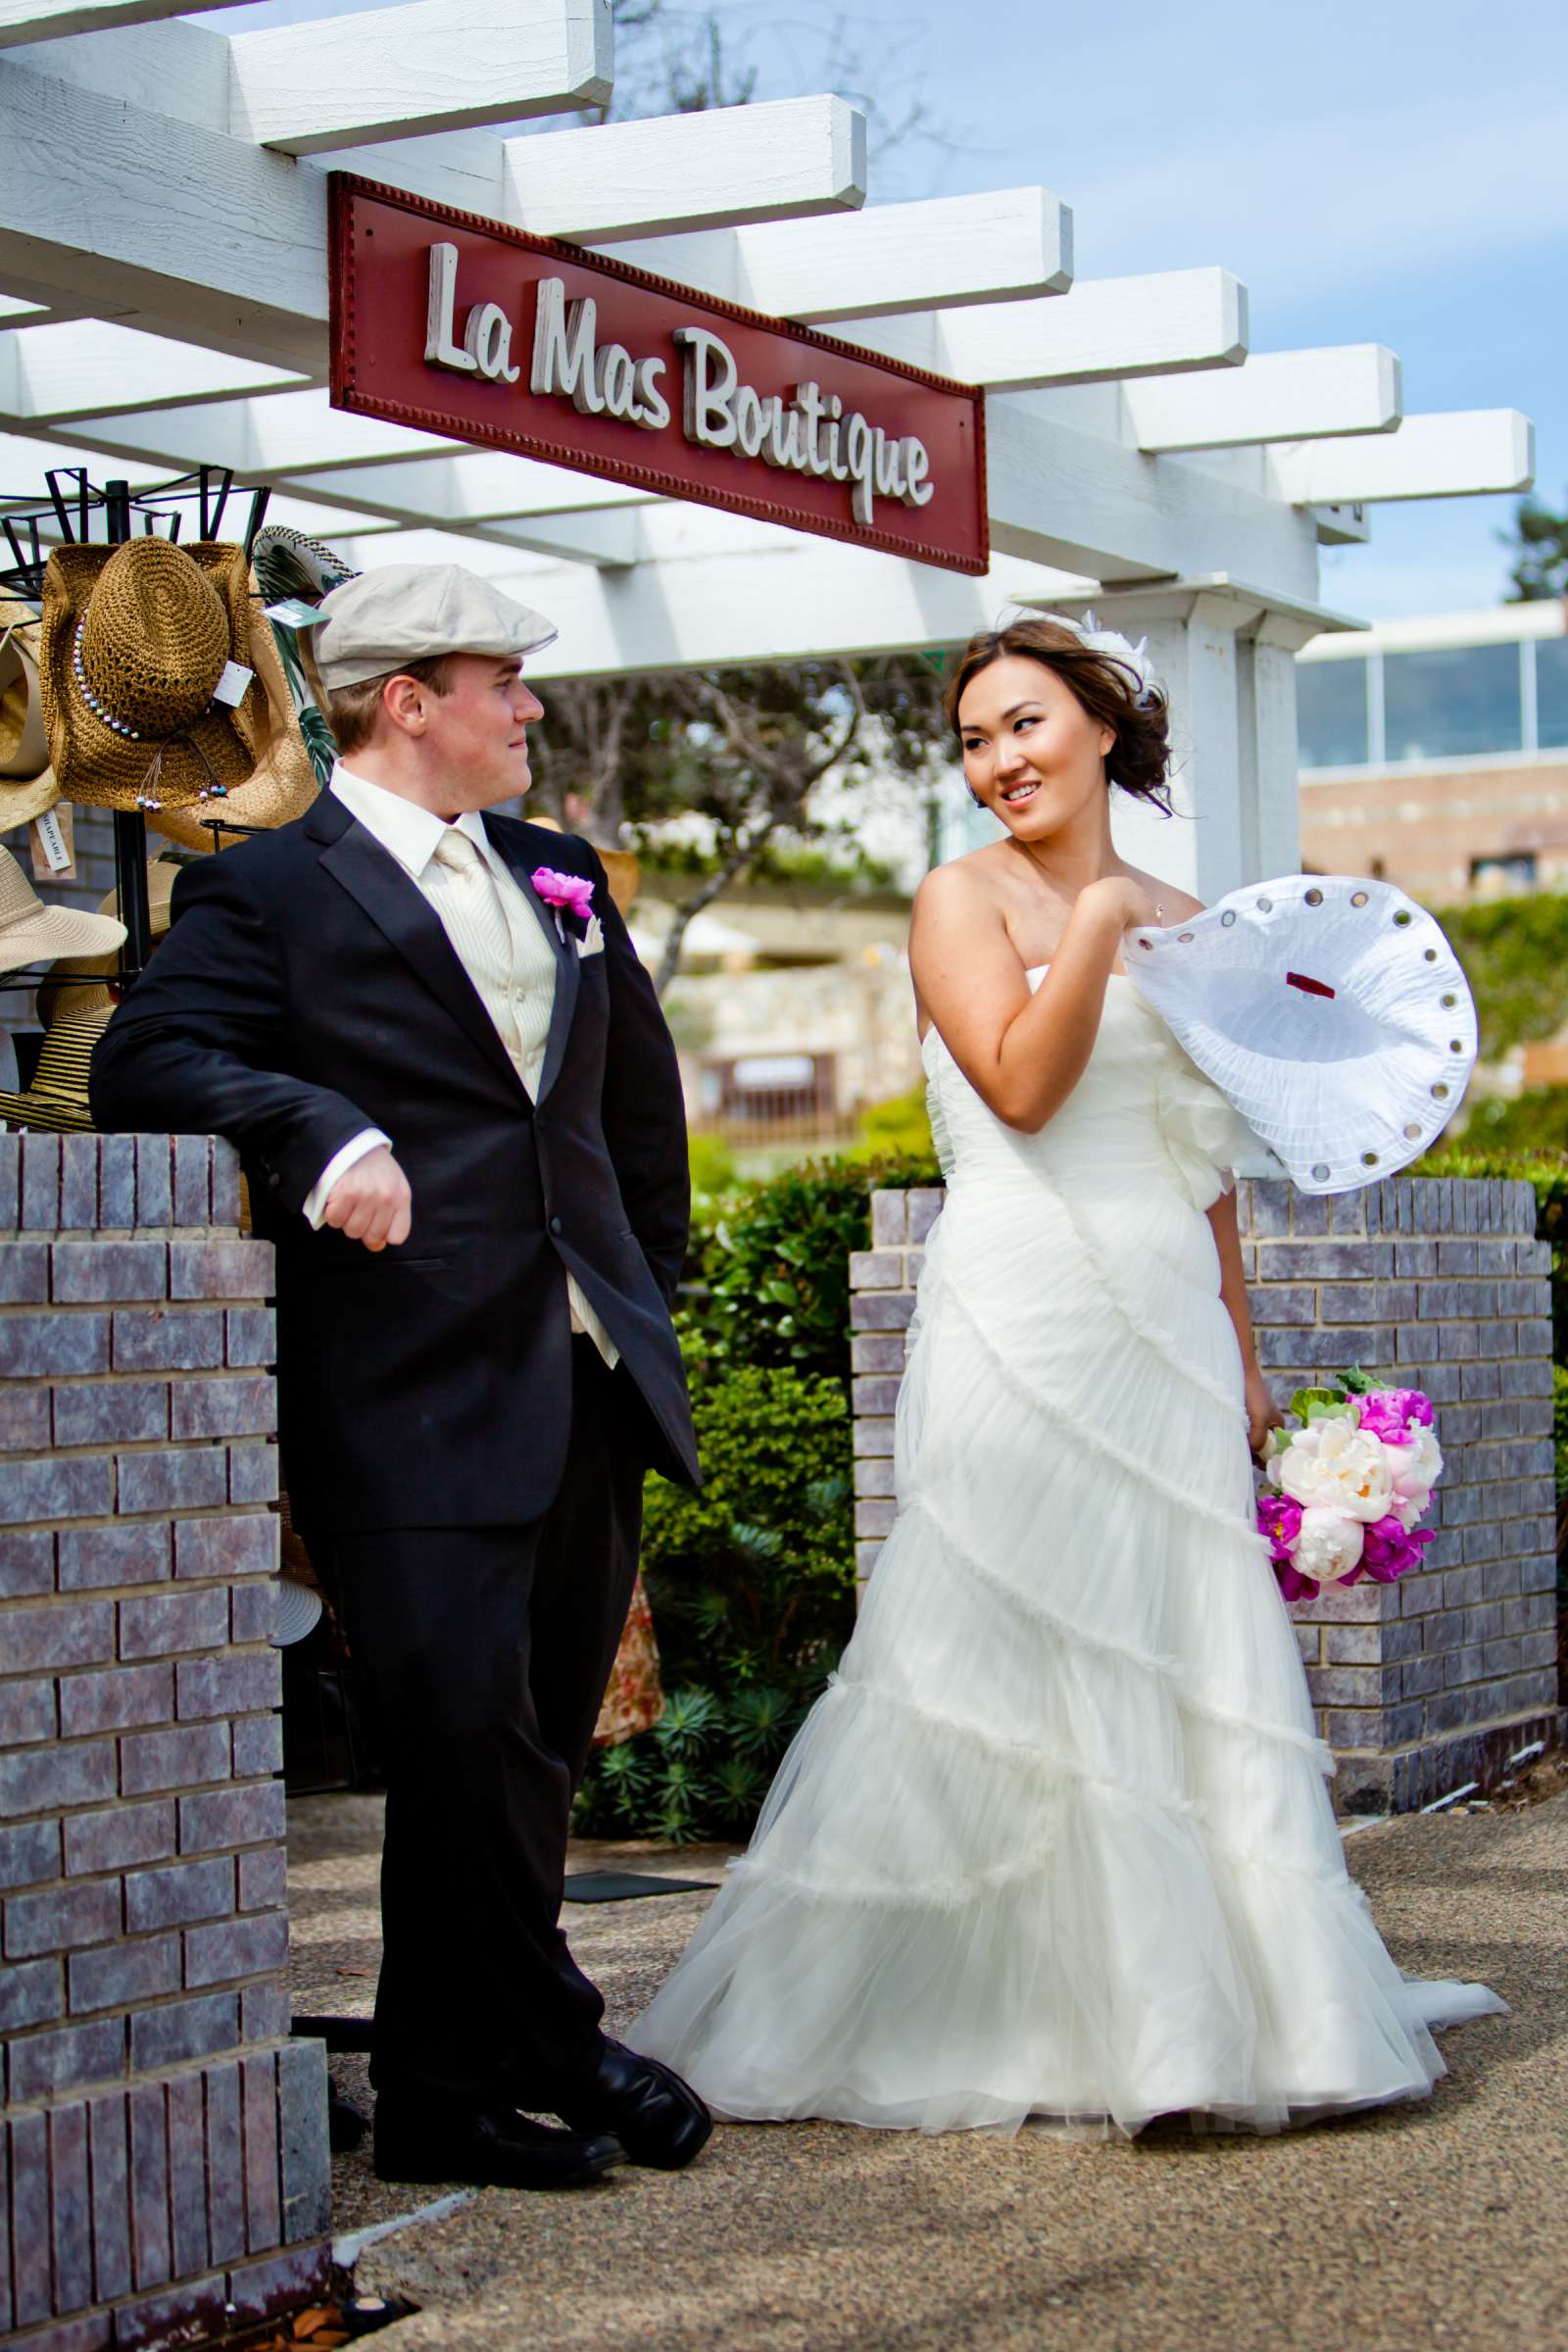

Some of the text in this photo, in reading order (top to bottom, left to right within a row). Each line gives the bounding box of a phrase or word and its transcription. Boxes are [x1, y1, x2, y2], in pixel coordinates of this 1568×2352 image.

[424, 242, 934, 524] La Mas Boutique
